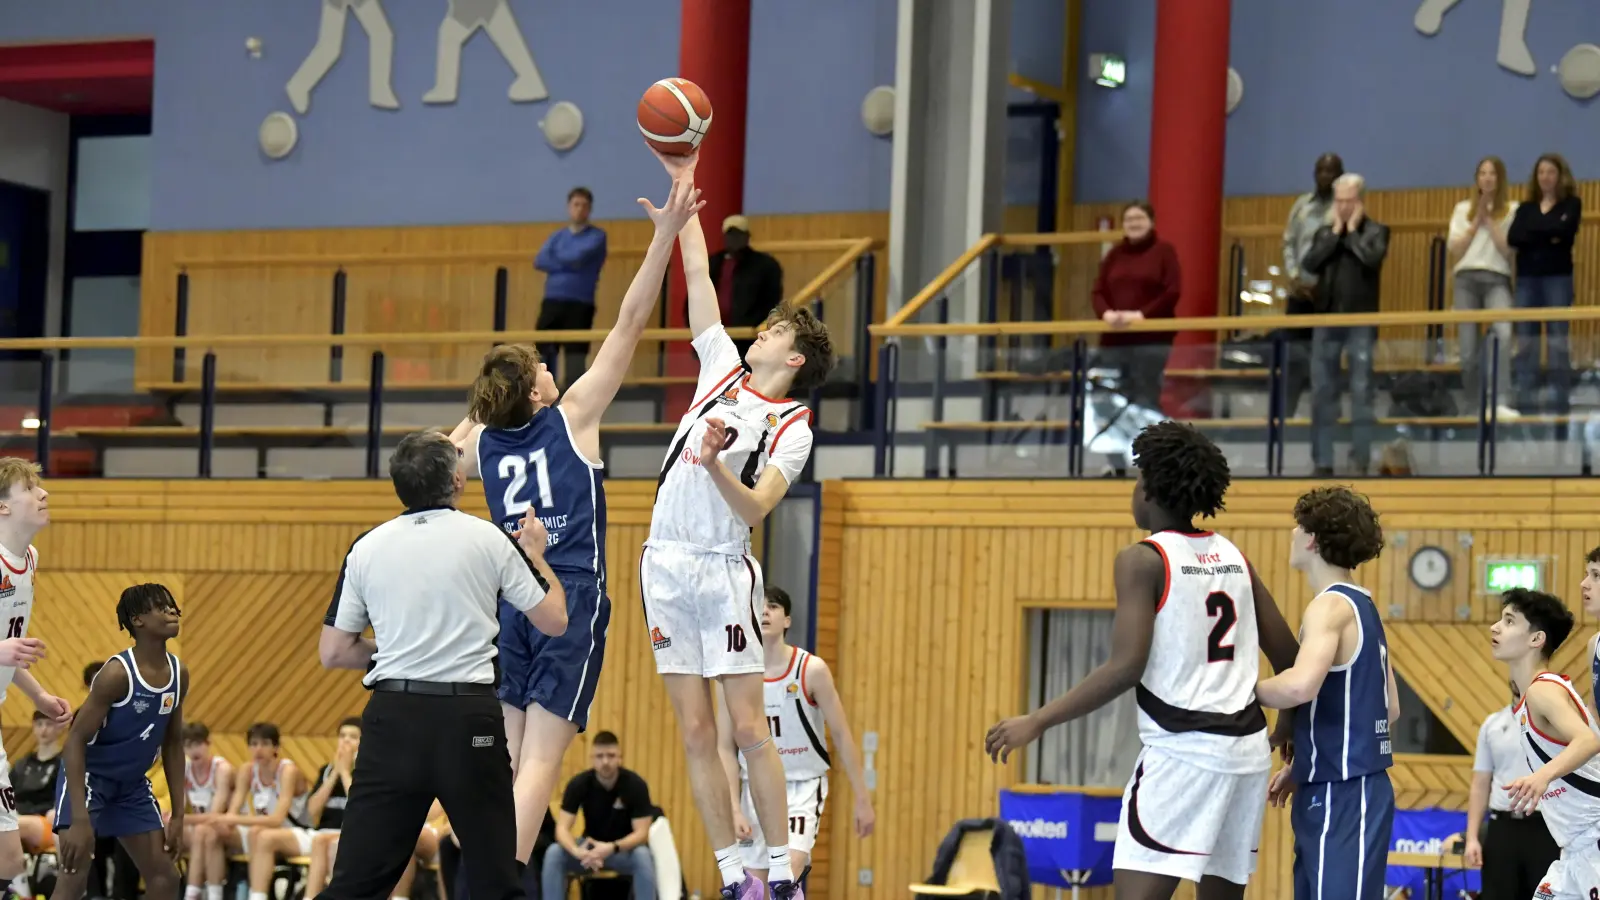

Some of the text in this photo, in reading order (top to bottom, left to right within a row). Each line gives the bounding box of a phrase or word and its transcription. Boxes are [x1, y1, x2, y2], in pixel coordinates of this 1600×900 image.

[498, 447, 554, 516] 21
[1195, 552, 1222, 565] Witt
[1215, 564, 1244, 575] HUNTERS
[6, 616, 25, 639] 16
[1205, 590, 1238, 664] 2
[725, 623, 747, 653] 10
[140, 723, 155, 741] 4
[777, 745, 809, 756] Gruppe
[0, 786, 16, 814] 16
[789, 816, 806, 835] 11
